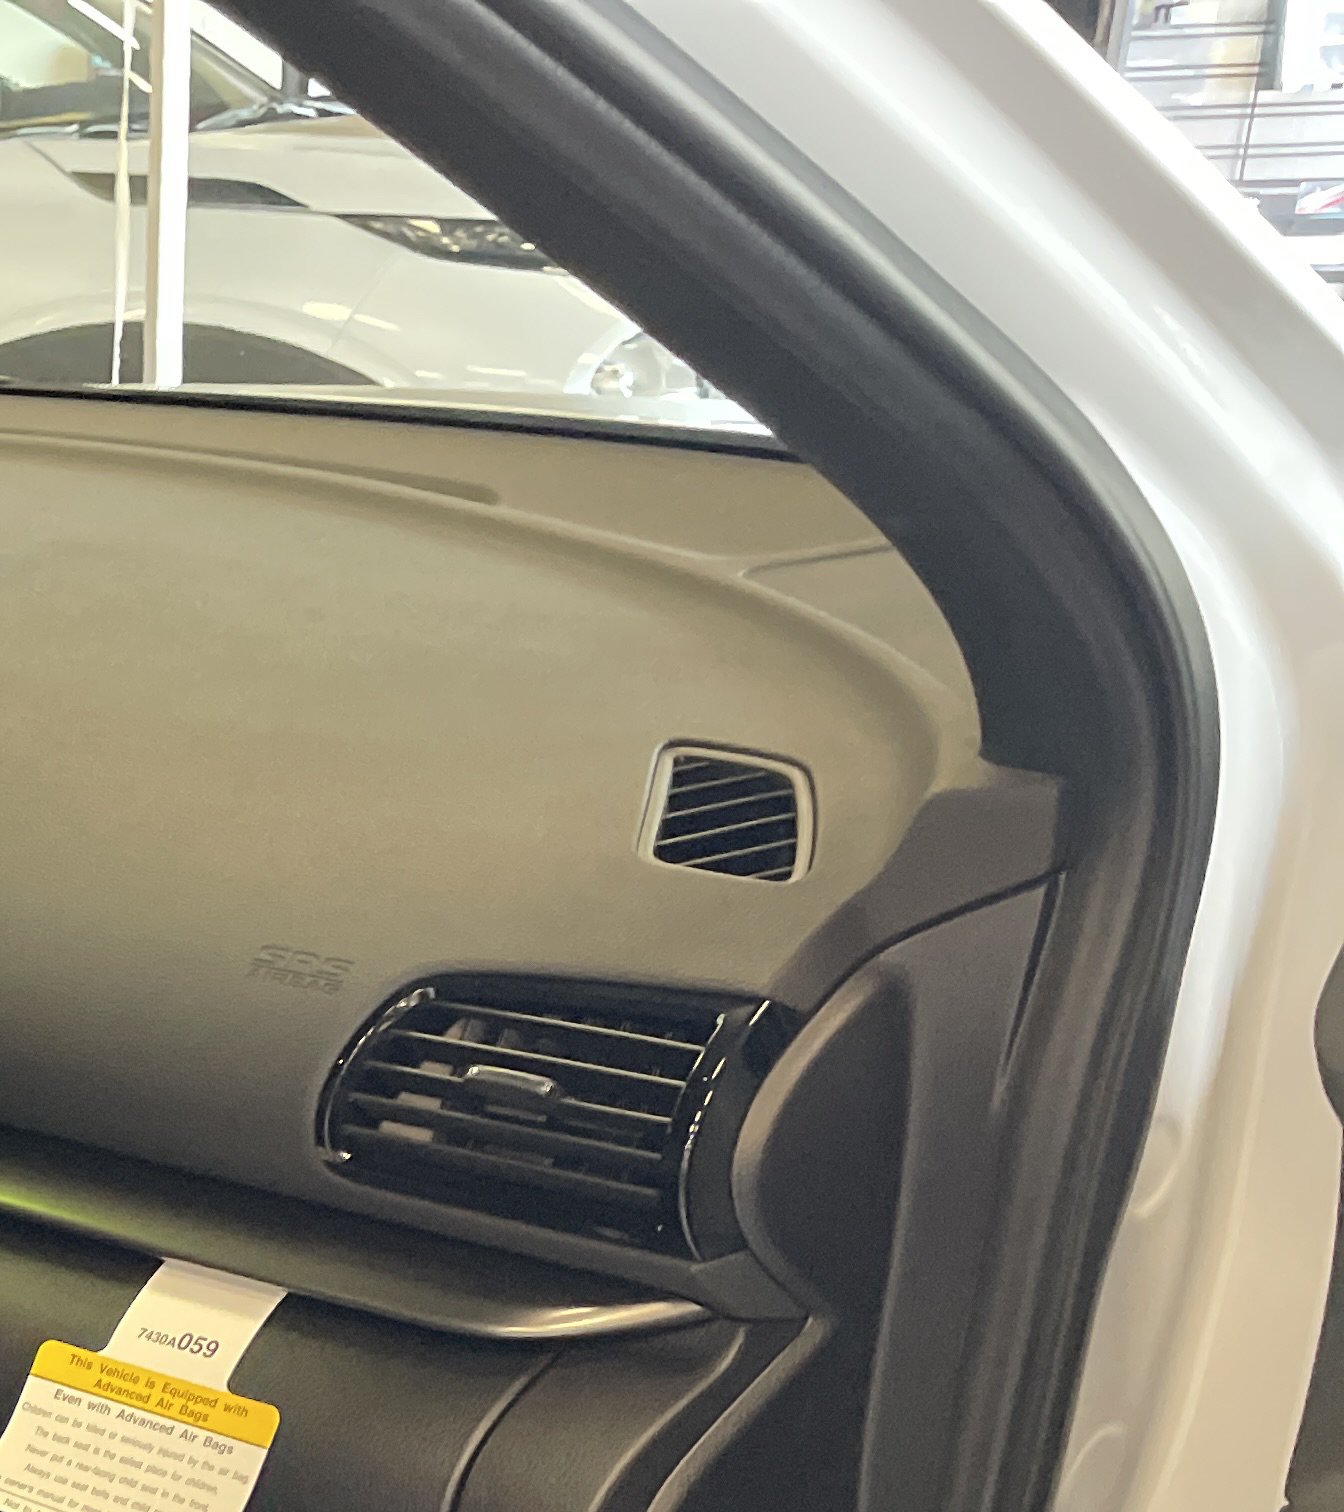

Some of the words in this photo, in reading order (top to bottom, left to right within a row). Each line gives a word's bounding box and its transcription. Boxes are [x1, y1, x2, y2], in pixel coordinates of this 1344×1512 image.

[70, 1353, 93, 1370] This
[100, 1363, 140, 1384] Vehicle
[145, 1376, 156, 1389] is
[162, 1382, 219, 1408] Equipped
[223, 1402, 248, 1417] with
[94, 1379, 151, 1405] Advanced
[155, 1398, 173, 1411] Air
[179, 1404, 210, 1423] Bags
[53, 1388, 82, 1407] Even
[87, 1400, 112, 1416] with
[116, 1409, 175, 1435] Advanced
[180, 1429, 198, 1443] Air
[203, 1436, 234, 1455] Bags
